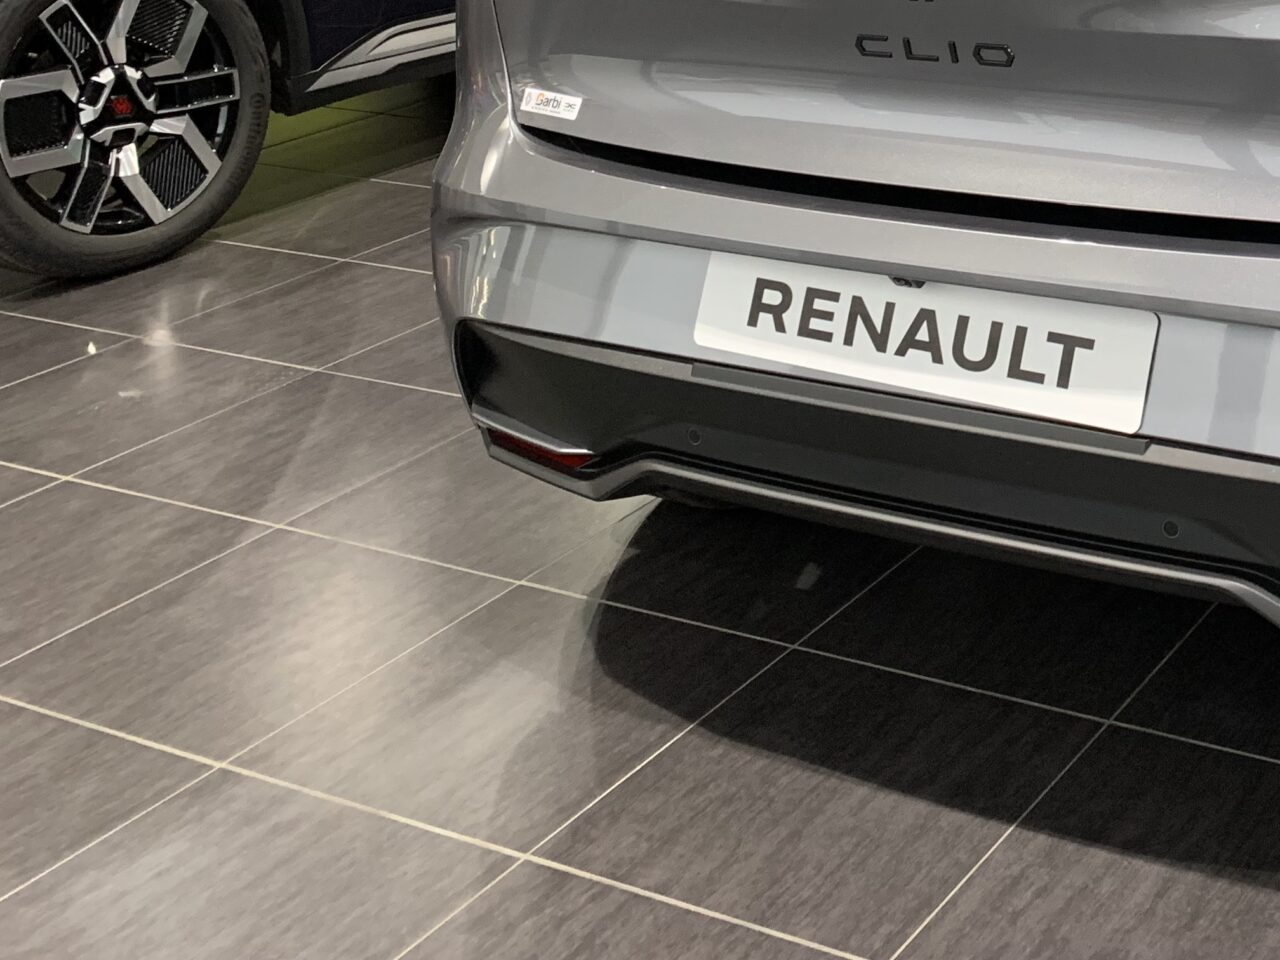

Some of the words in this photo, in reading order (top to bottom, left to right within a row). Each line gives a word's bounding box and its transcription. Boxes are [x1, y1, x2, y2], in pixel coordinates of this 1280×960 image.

[854, 33, 1016, 68] CLIO
[535, 92, 562, 111] Garbi
[747, 277, 1096, 390] RENAULT
